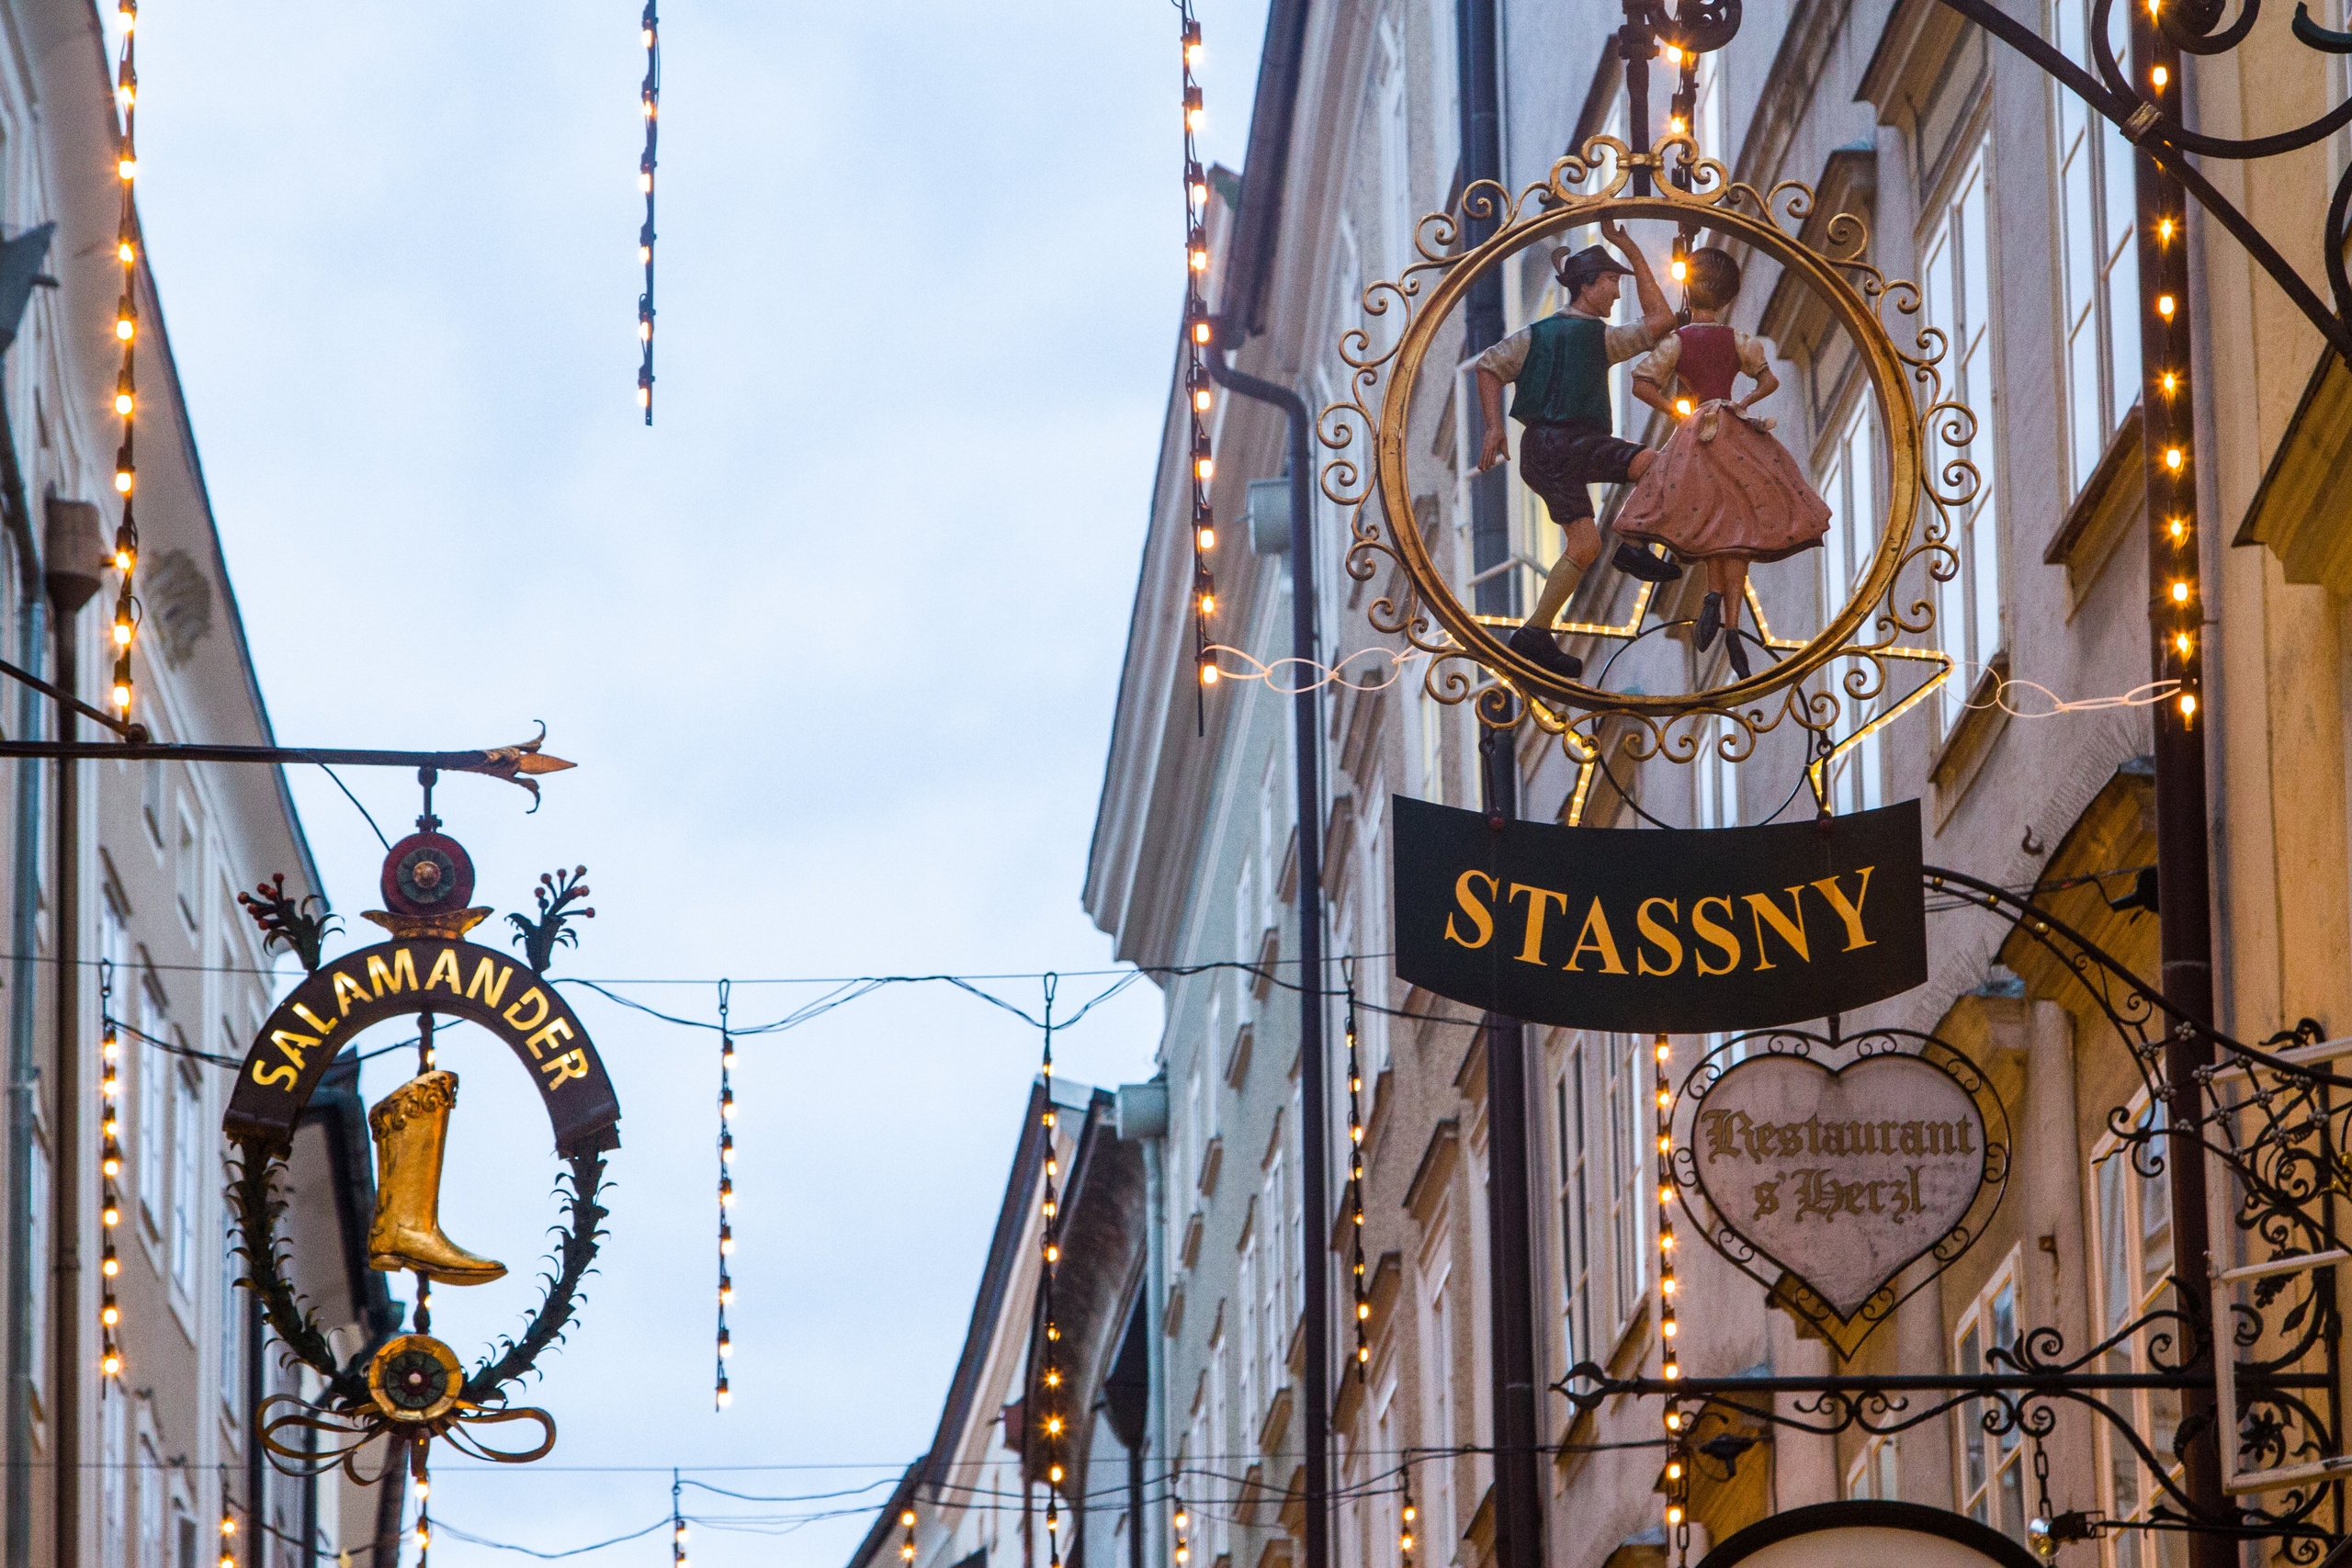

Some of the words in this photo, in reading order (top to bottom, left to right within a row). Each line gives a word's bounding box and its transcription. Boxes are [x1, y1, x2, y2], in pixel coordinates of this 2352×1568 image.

[1443, 865, 1876, 976] STASSNY
[252, 948, 589, 1092] SALAMANDER
[1701, 1109, 1977, 1165] Restaurant
